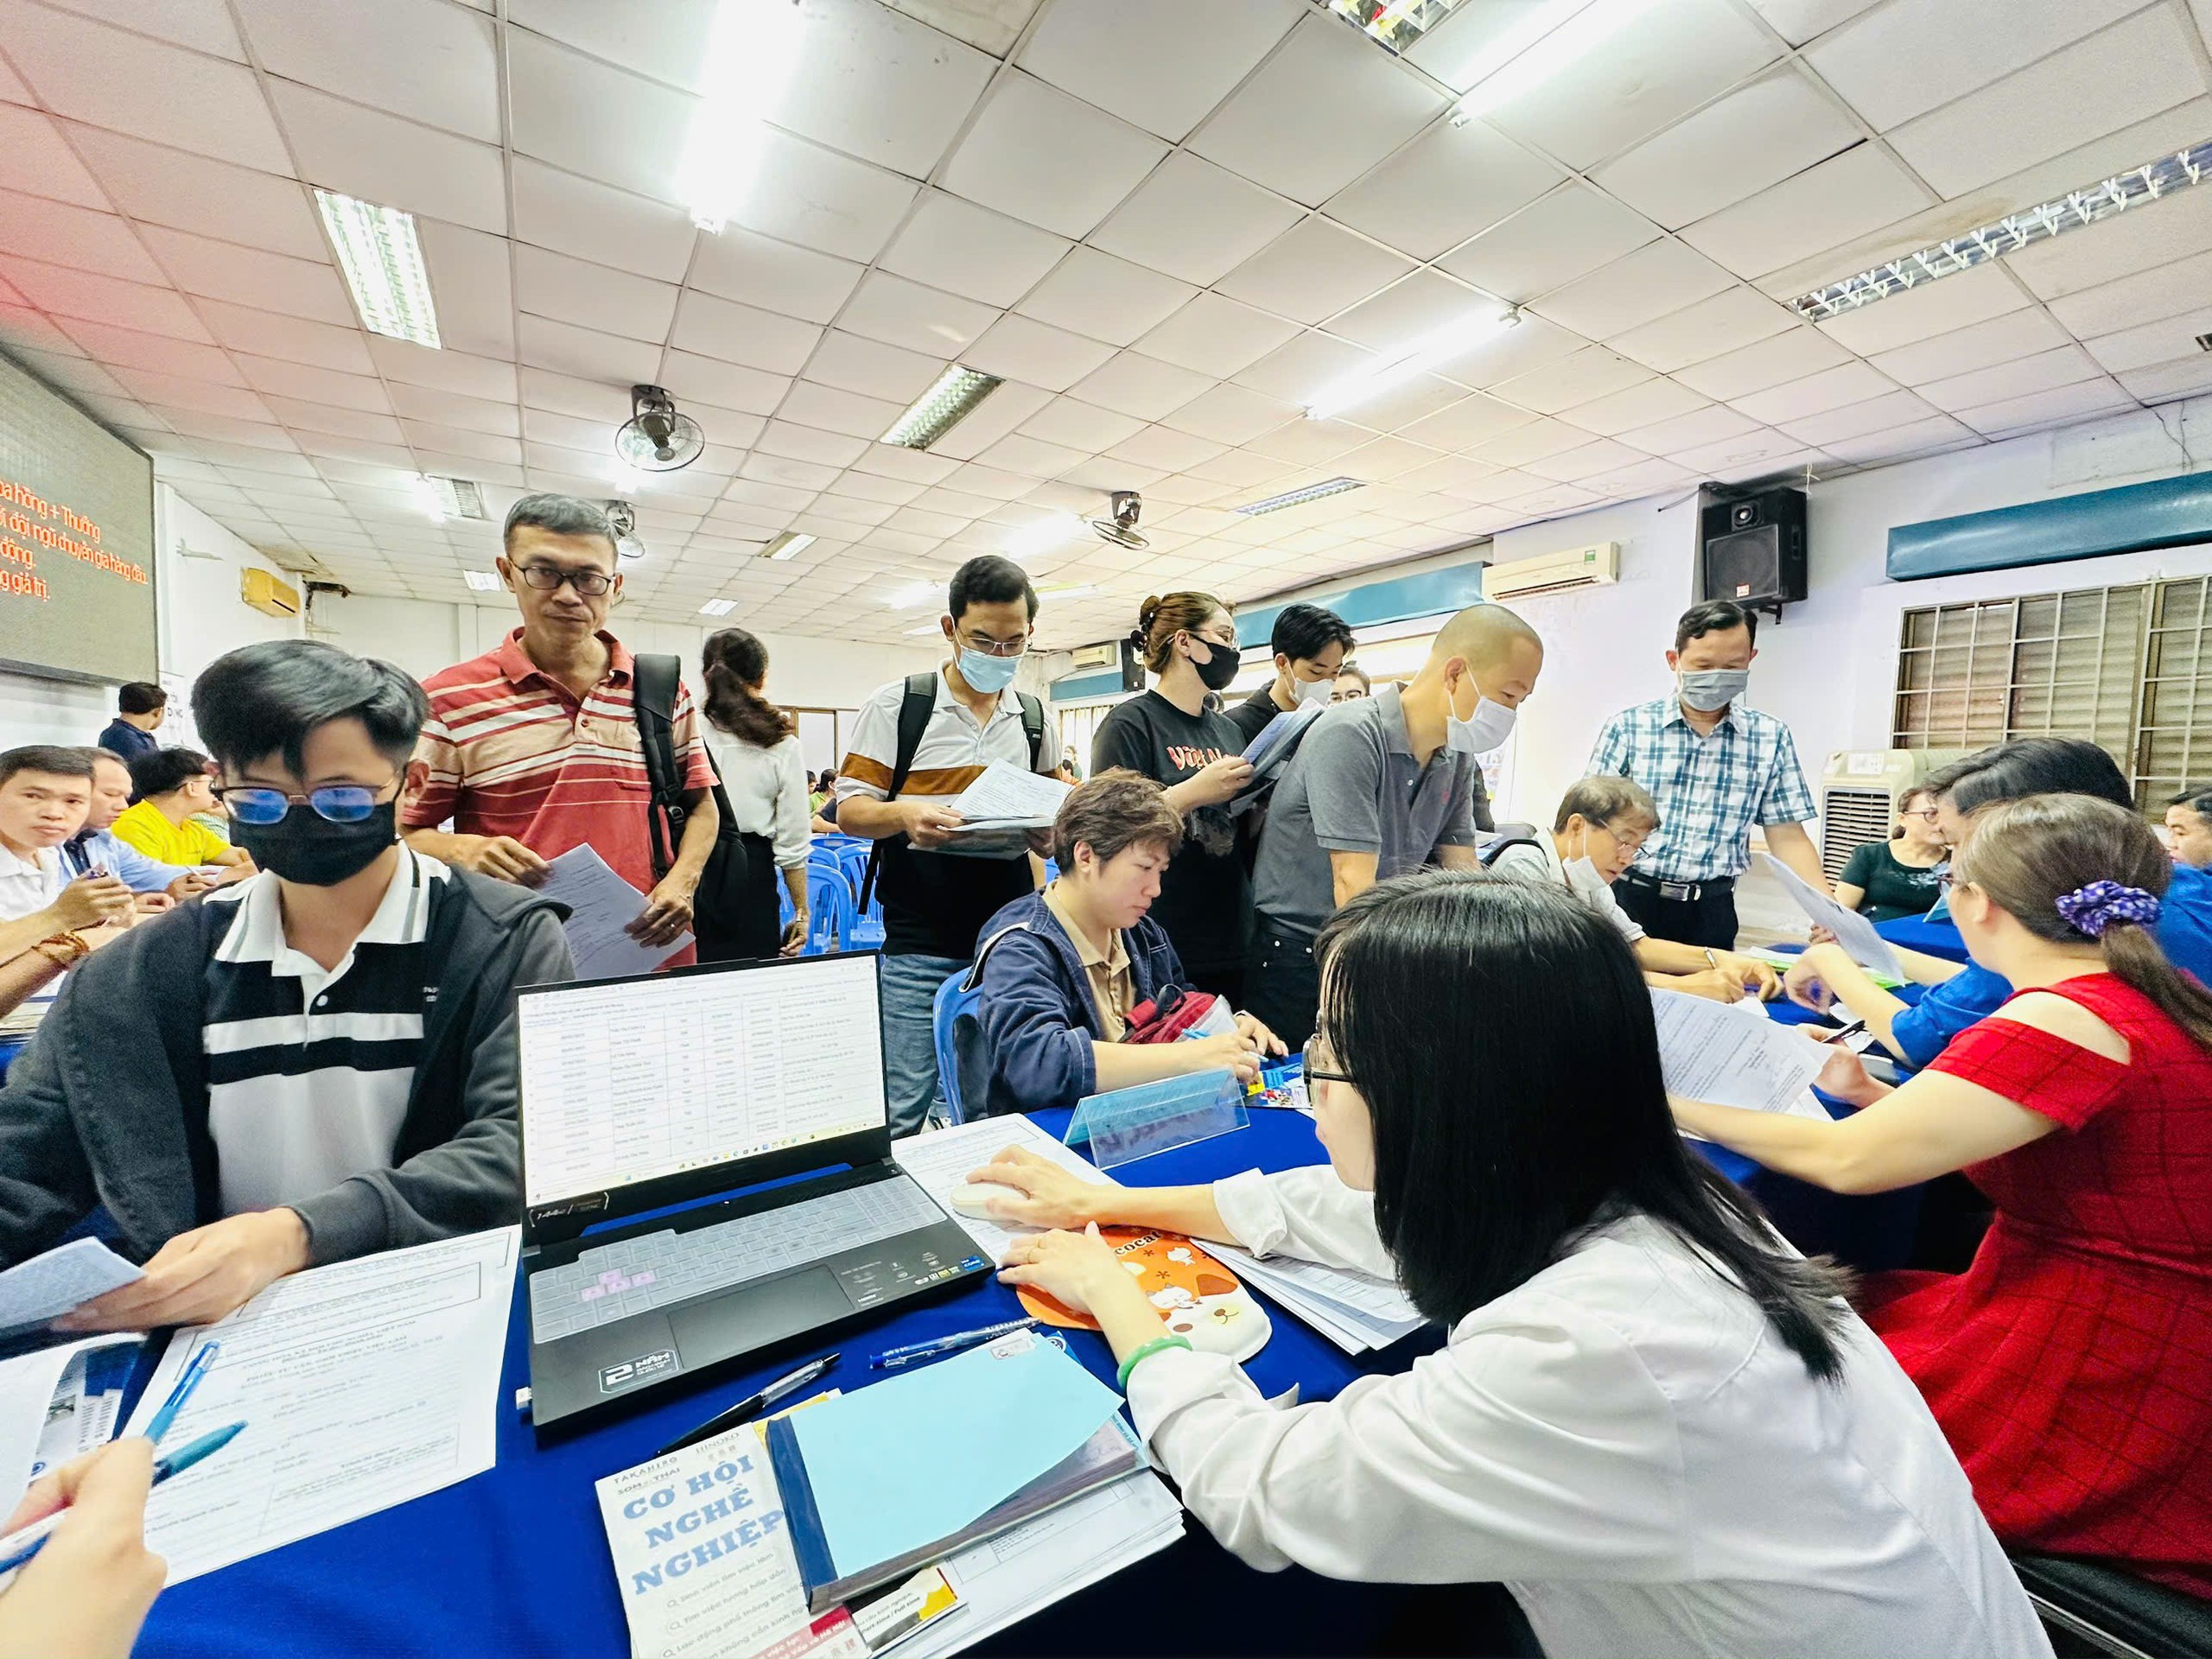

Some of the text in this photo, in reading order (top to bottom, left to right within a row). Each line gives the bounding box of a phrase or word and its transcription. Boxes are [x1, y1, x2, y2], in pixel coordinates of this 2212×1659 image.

[605, 1363, 634, 1386] 2
[613, 1456, 677, 1484] TAKAHIRO
[696, 1432, 740, 1454] HINOKO
[623, 1454, 754, 1519] CƠ HỘI
[653, 1466, 680, 1481] THAI
[645, 1483, 753, 1548] NGHỀ
[632, 1510, 785, 1595] NGHIỆP
